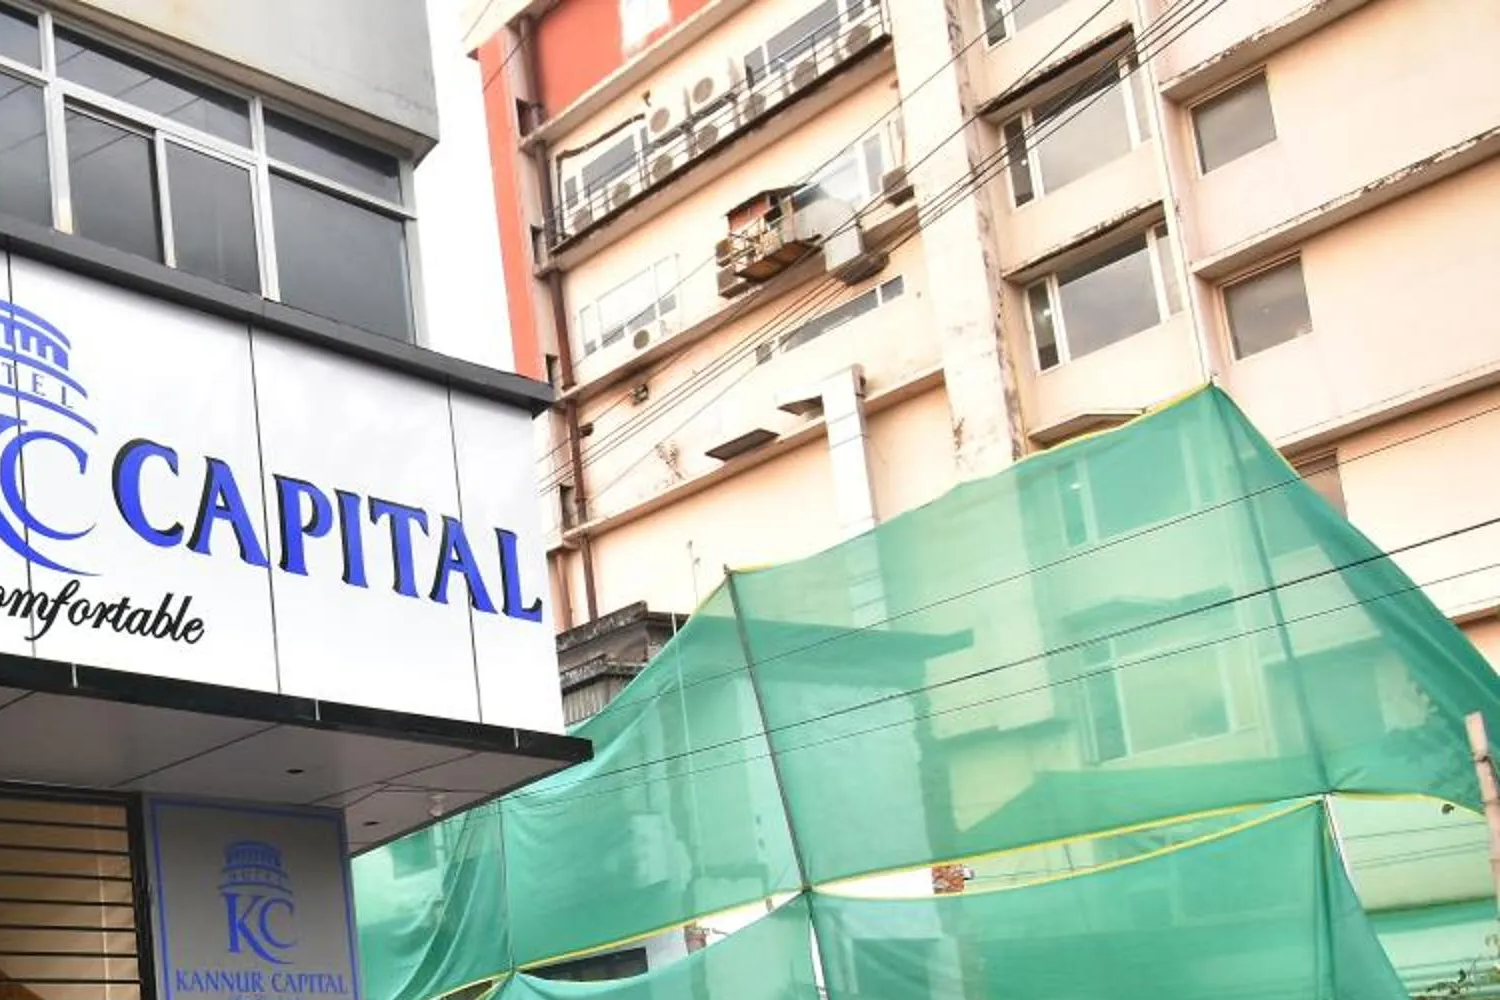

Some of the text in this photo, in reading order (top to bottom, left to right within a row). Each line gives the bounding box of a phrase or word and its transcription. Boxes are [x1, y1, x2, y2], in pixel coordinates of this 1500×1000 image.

[112, 438, 543, 623] CAPITAL
[220, 891, 298, 965] KC
[175, 968, 348, 995] KANNUR CAPITAL
